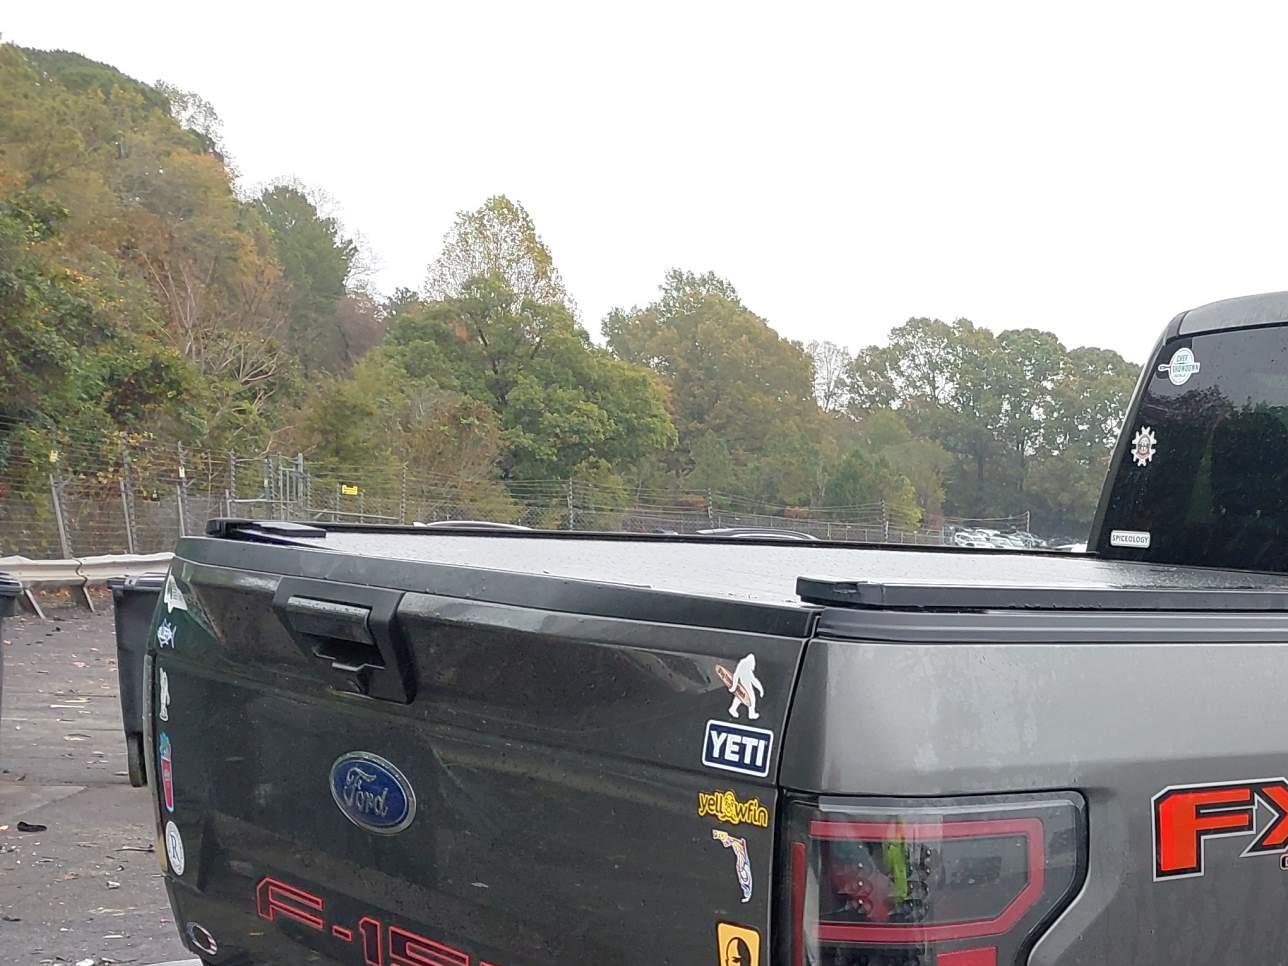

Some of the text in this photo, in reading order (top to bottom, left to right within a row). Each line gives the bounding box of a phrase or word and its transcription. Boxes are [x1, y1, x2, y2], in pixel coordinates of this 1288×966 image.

[1112, 534, 1149, 543] SPICEOLOGY
[710, 730, 766, 767] YETI
[343, 767, 389, 817] Ford
[698, 789, 768, 828] yellowfin
